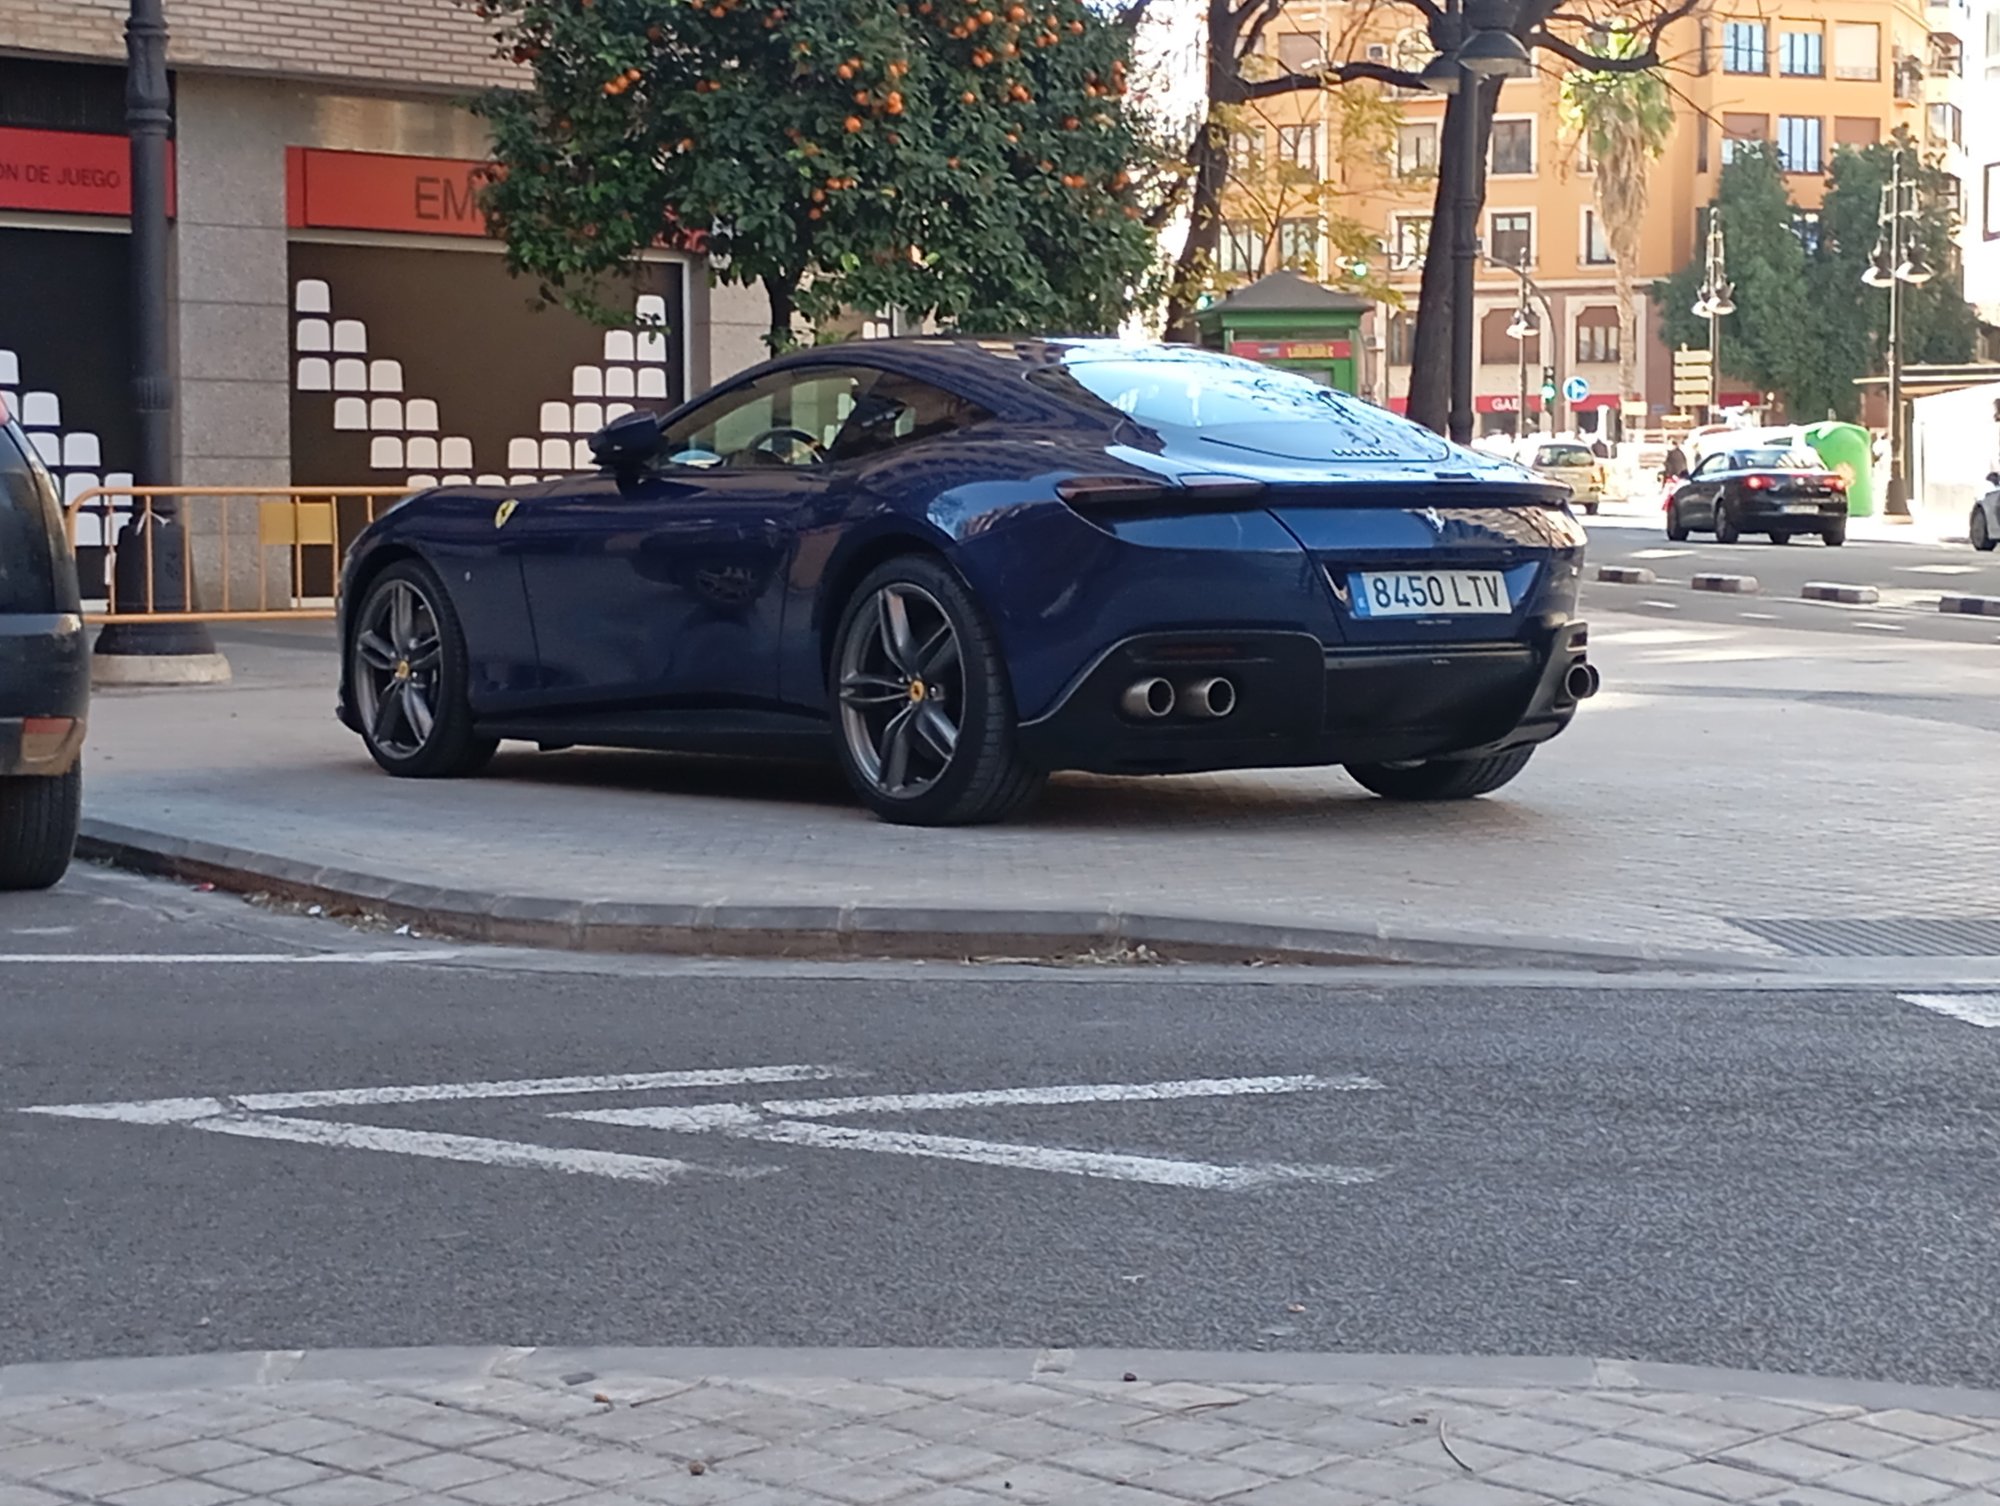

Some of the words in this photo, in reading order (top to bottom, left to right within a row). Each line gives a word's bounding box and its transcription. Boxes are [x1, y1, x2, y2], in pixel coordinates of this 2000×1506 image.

[25, 164, 50, 184] DE
[57, 167, 121, 189] JUEGO
[1373, 576, 1445, 608] 8450
[1450, 575, 1499, 608] LTV
